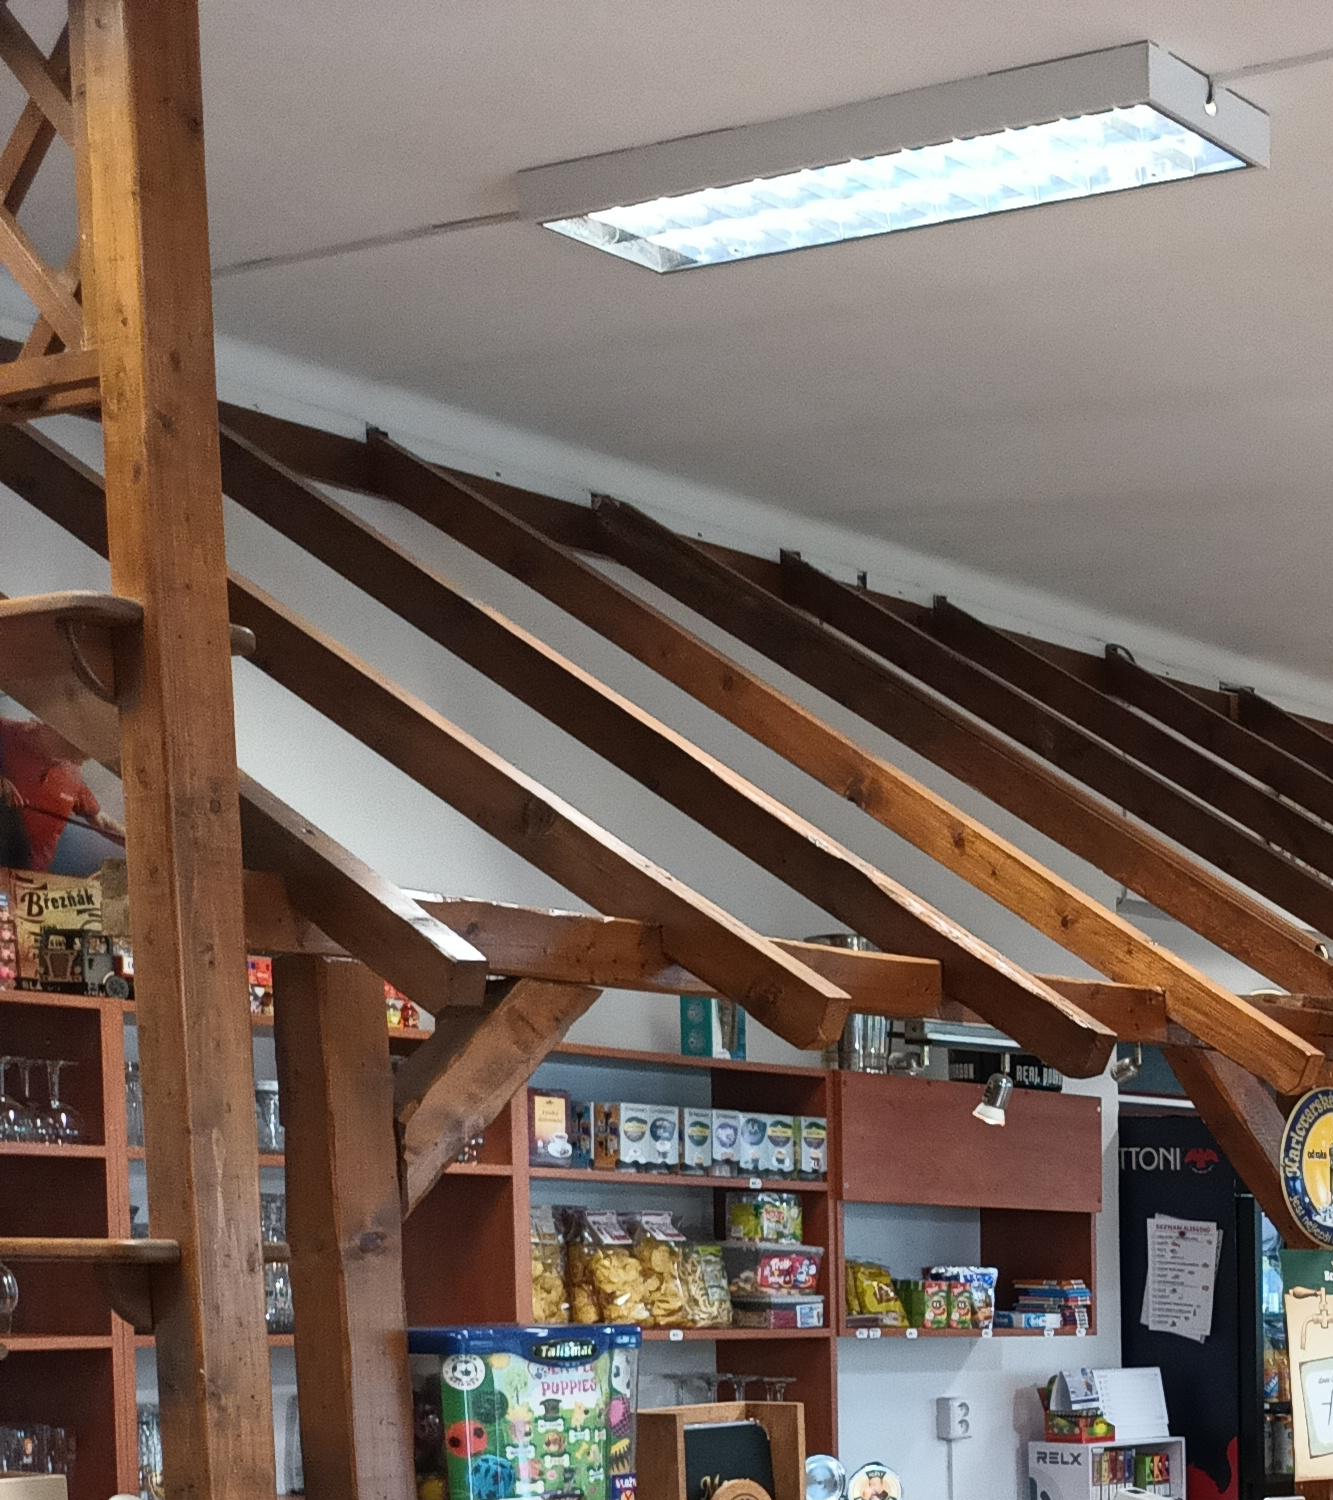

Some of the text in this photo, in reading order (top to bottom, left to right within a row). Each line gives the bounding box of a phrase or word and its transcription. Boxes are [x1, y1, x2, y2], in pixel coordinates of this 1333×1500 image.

[20, 888, 95, 918] Březňák
[541, 1380, 597, 1397] PUPPIES
[1036, 1451, 1082, 1466] RELX
